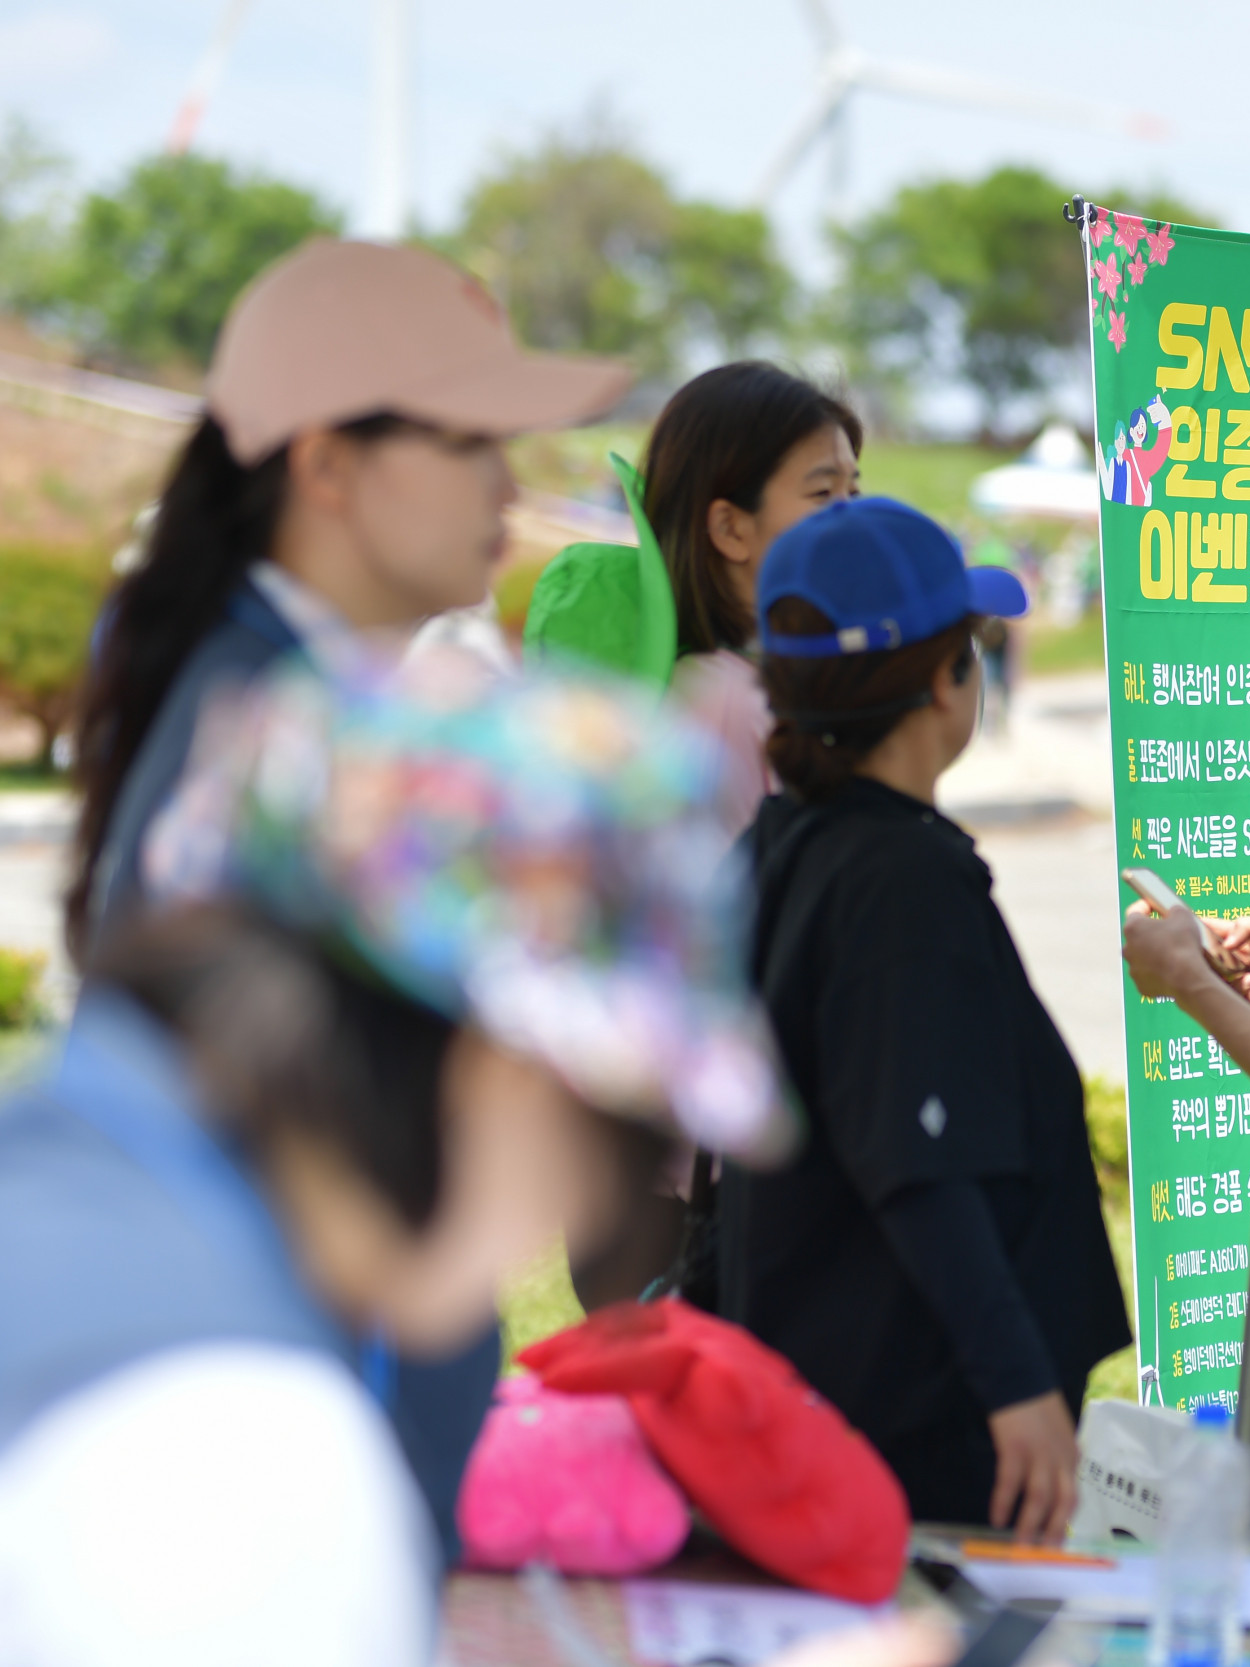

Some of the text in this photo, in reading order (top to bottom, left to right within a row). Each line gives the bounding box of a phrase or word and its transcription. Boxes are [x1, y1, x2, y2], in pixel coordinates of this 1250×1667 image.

[1124, 662, 1148, 704] 하나.
[1153, 664, 1219, 705] 행사참여
[1140, 740, 1199, 782] 포토존에서
[1133, 819, 1145, 858] 셋.
[1147, 818, 1172, 859] 찍은
[1178, 815, 1237, 858] 사진들을
[1190, 877, 1213, 896] 필수
[1169, 1037, 1203, 1080] 업로드
[1173, 1097, 1209, 1142] 추억의
[1176, 1176, 1206, 1217] 해당
[1212, 1170, 1242, 1213] 경품
[1166, 1254, 1175, 1281] 1등
[1176, 1250, 1207, 1277] 아이패드
[1169, 1302, 1179, 1329] 2등
[1173, 1350, 1182, 1376] 3등
